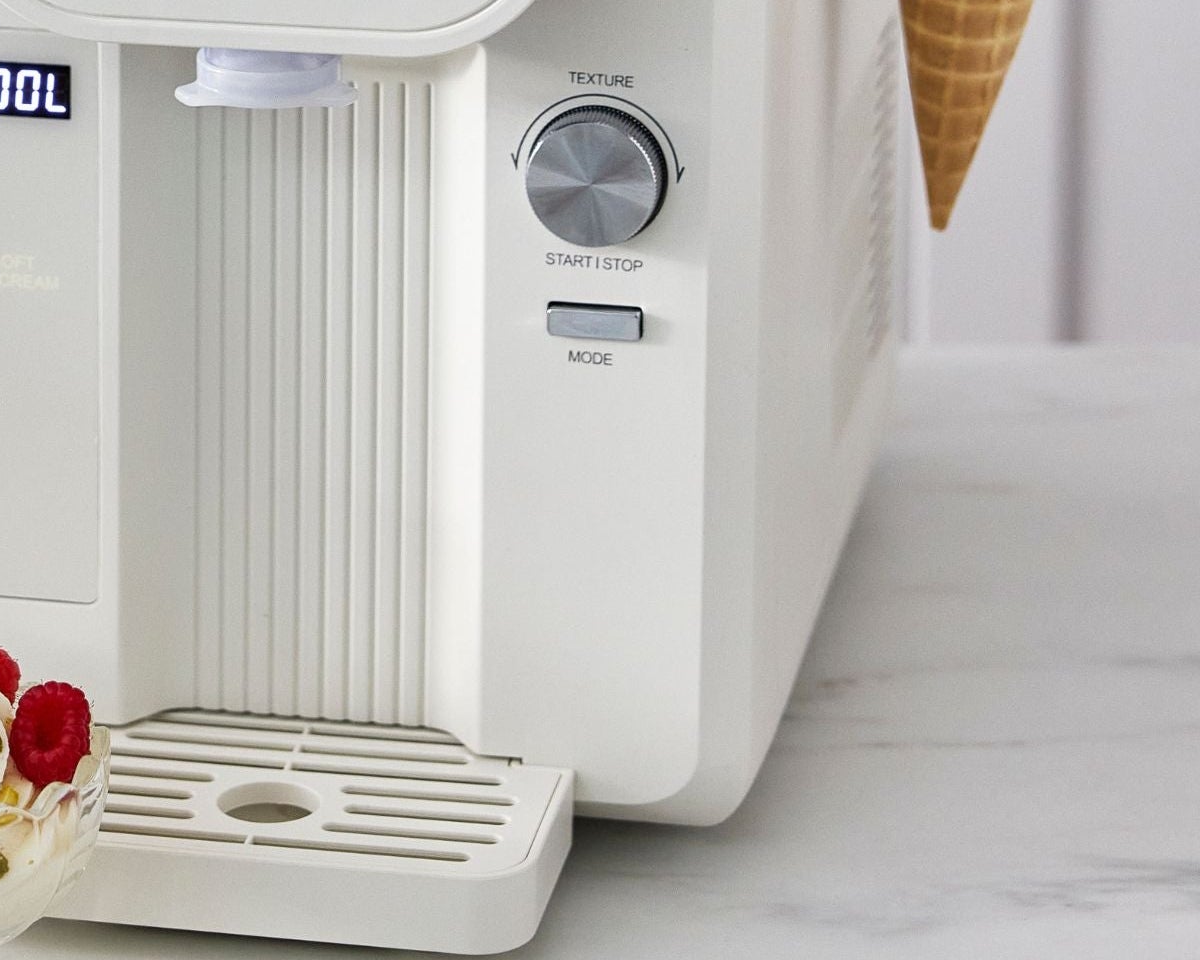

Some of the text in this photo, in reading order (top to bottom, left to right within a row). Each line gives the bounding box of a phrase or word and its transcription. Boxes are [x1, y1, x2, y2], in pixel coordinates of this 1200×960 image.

[568, 71, 634, 89] TEXTURE
[545, 252, 593, 268] START
[602, 257, 643, 272] STOP
[568, 350, 613, 366] MODE
